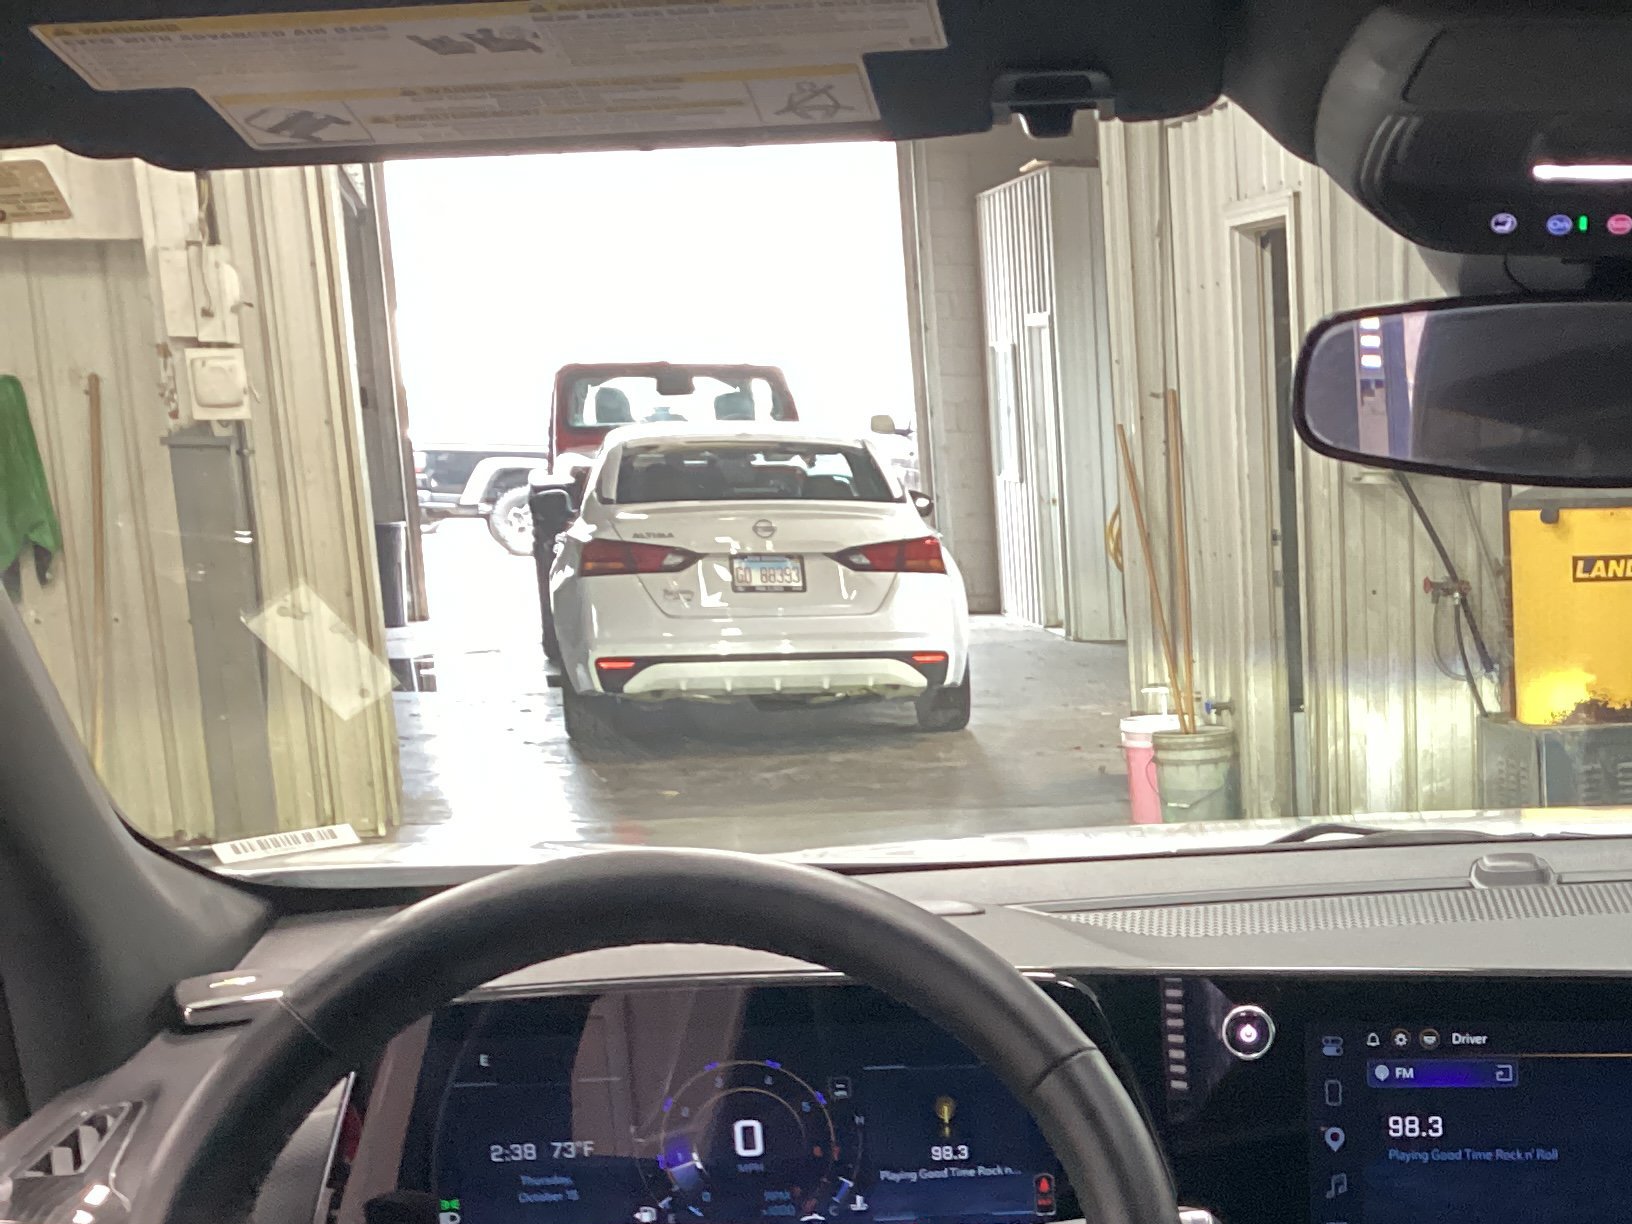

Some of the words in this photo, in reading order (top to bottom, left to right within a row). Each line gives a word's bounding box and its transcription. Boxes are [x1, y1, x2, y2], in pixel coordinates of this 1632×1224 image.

[1451, 1033, 1488, 1045] Driver
[1395, 1067, 1415, 1080] FM
[1388, 1115, 1444, 1138] 98.3
[733, 1119, 765, 1158] 0
[490, 1142, 537, 1163] 2:38
[550, 1140, 596, 1159] 73°F
[930, 1145, 970, 1161] 98.3
[1388, 1149, 1428, 1163] Playing
[1431, 1148, 1462, 1161] Good
[1464, 1148, 1493, 1161] Time
[879, 1169, 918, 1183] Playing
[919, 1167, 949, 1180] Good
[949, 1166, 977, 1178] Time
[977, 1164, 1004, 1177] Rock
